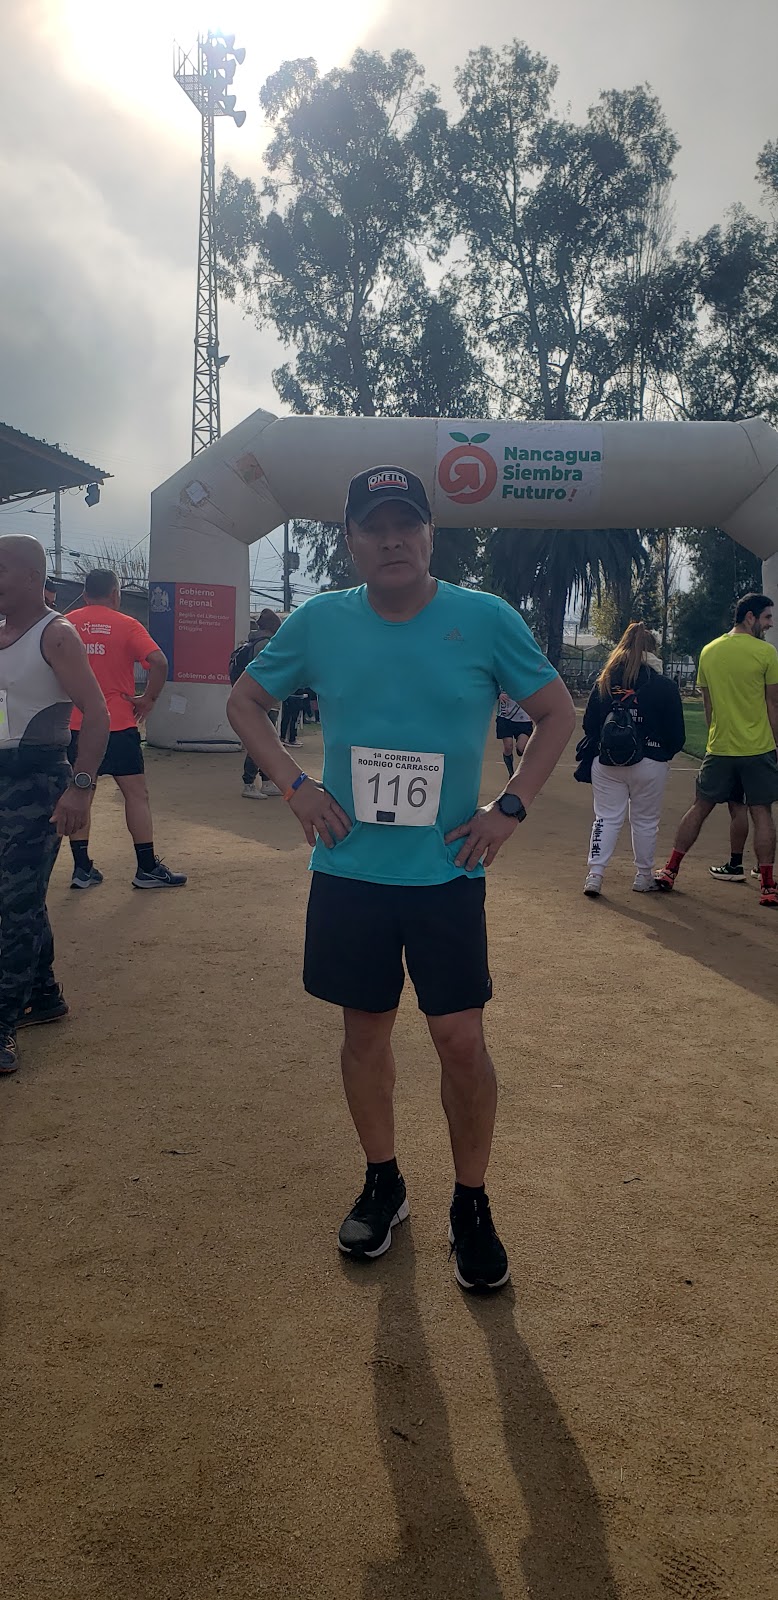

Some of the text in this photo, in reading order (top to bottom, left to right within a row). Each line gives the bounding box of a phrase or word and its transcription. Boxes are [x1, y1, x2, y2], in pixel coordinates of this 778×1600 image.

[504, 446, 601, 465] Nancagua
[503, 463, 583, 481] Siembra
[179, 587, 215, 597] Gobierno
[179, 598, 213, 608] Regional
[177, 671, 207, 680] Gobierno
[384, 753, 422, 763] CORRIDA
[358, 758, 440, 772] RODRIGO CARRASCO
[367, 772, 428, 808] 116
